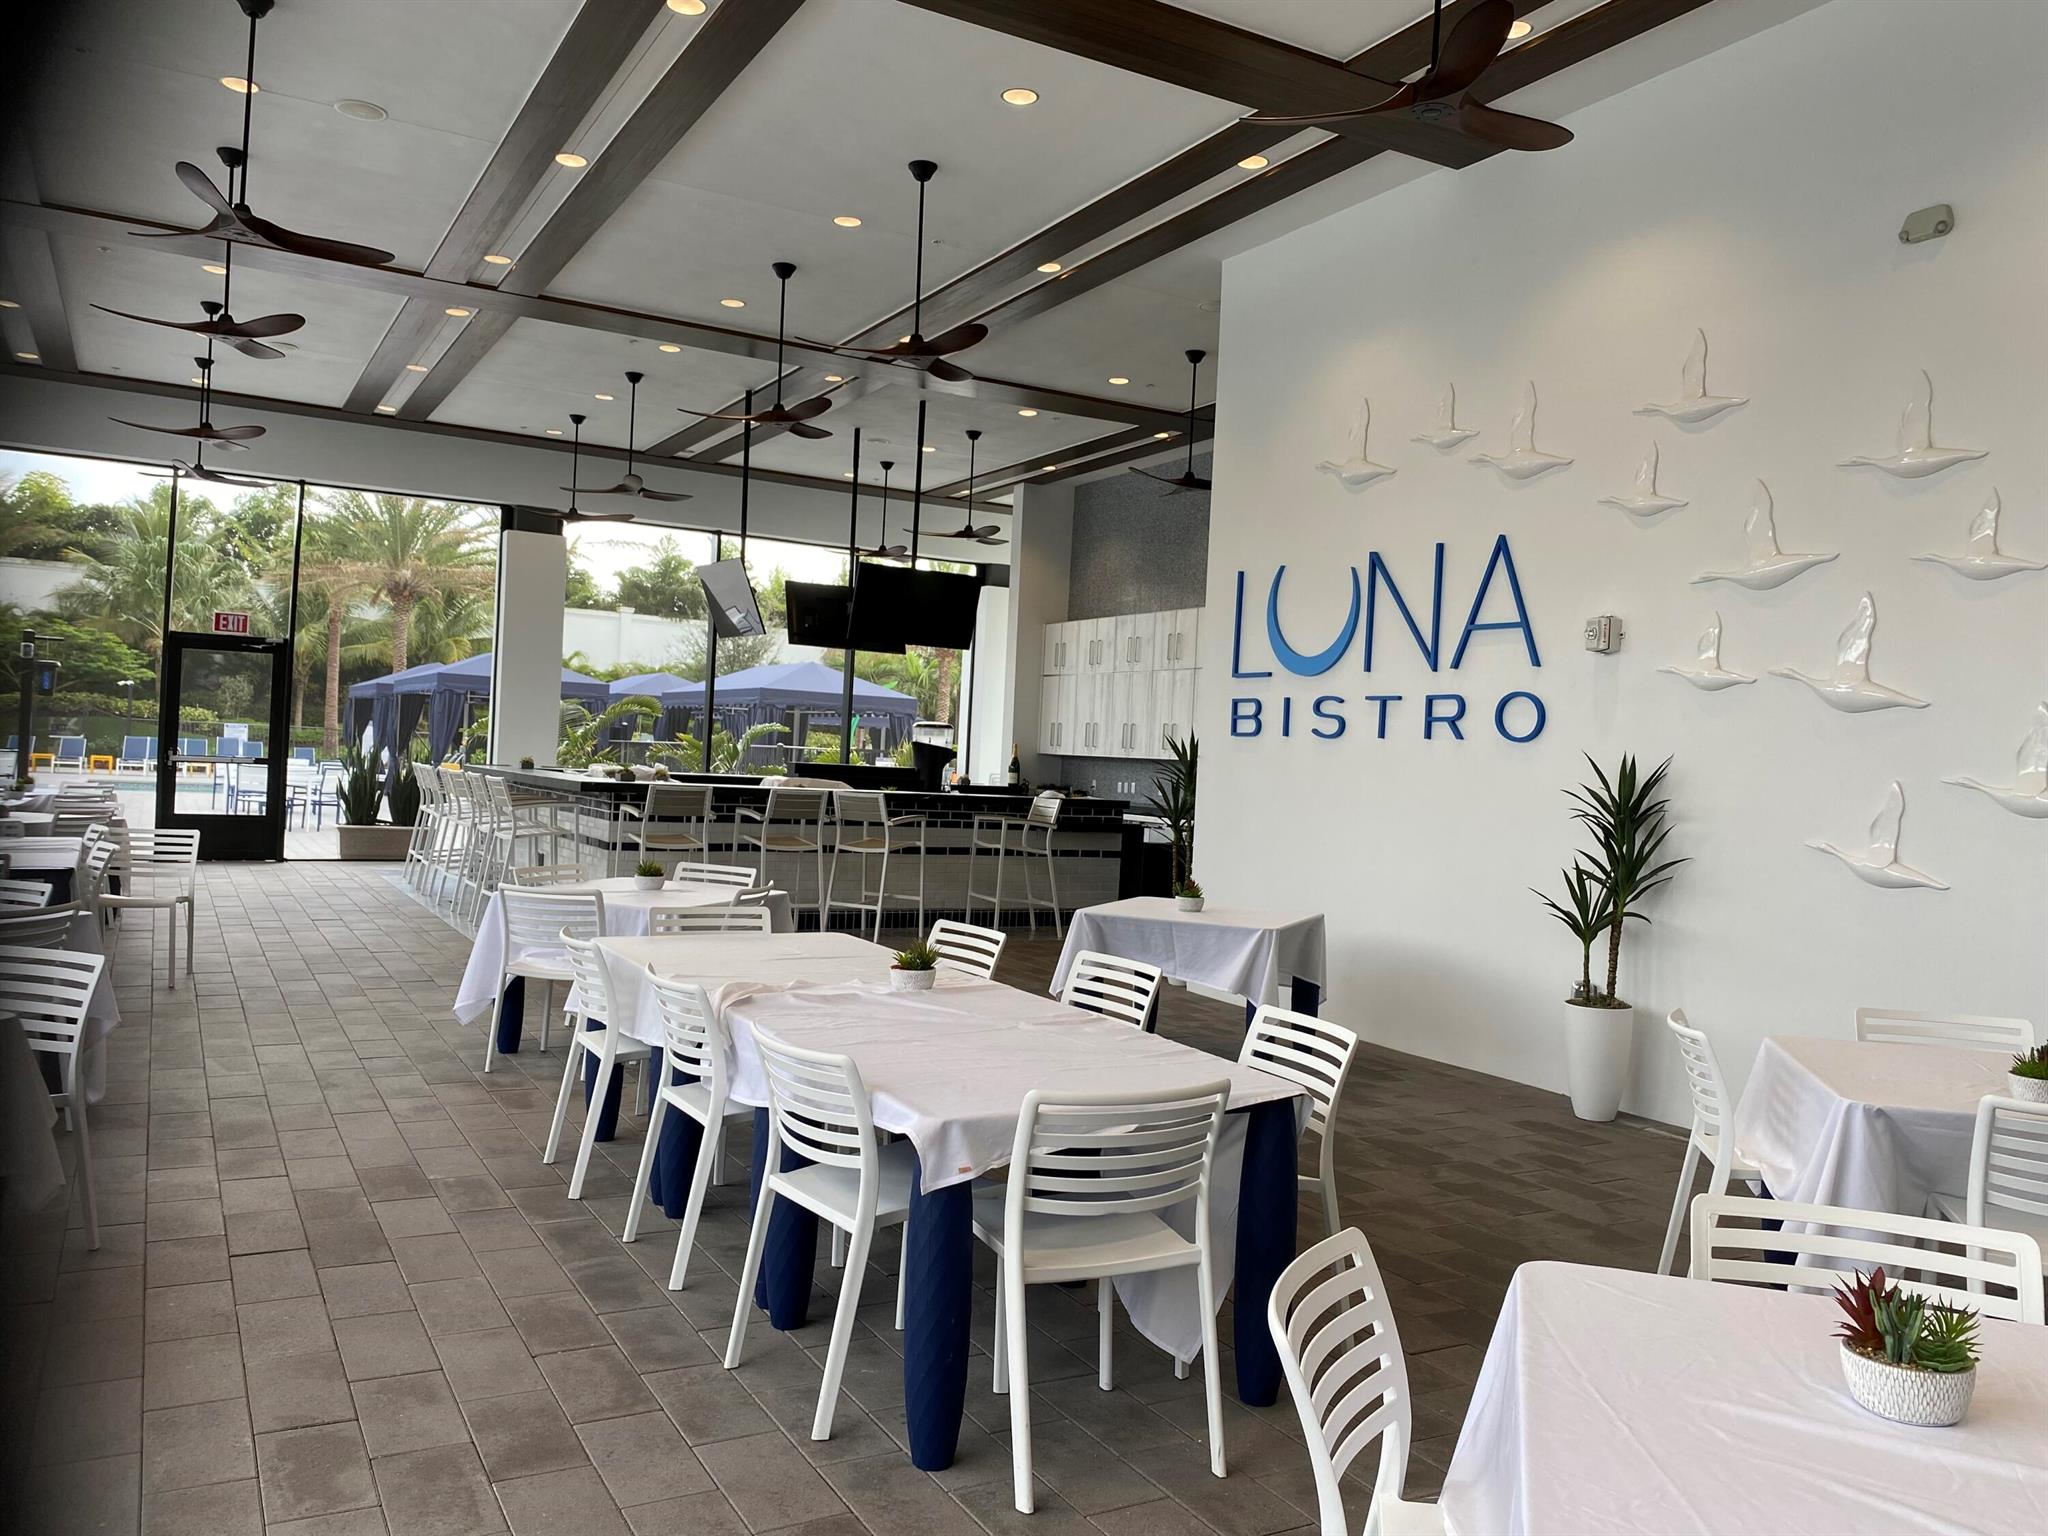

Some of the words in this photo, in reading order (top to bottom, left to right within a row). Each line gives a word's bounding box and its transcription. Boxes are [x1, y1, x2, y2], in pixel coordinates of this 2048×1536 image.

[219, 614, 245, 632] EXIT
[1231, 534, 1541, 678] LUNA
[1230, 691, 1547, 743] BISTRO
